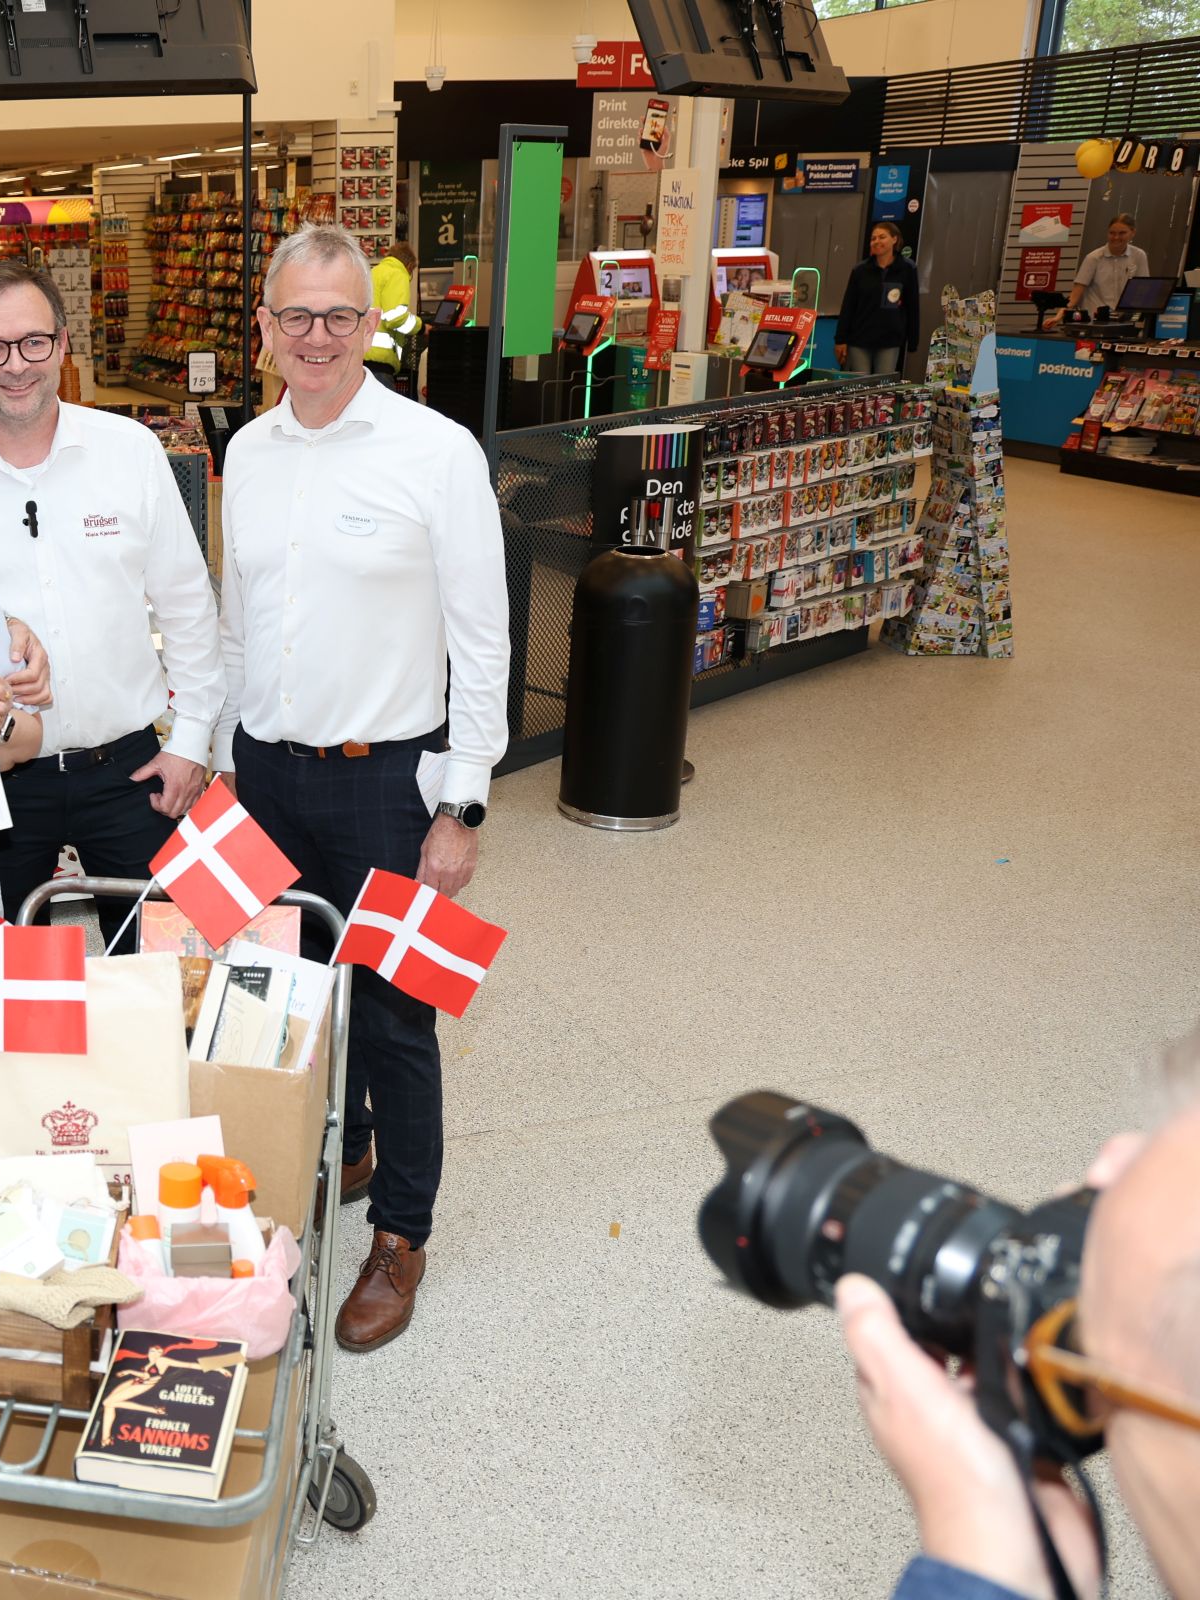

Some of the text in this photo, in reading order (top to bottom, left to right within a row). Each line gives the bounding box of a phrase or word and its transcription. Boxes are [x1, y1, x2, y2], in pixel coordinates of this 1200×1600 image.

[599, 99, 627, 111] Print
[597, 117, 640, 129] direkte
[596, 135, 635, 147] fra din
[595, 153, 633, 165] mobil!
[749, 157, 769, 169] Spil
[829, 163, 856, 171] Danmark
[604, 272, 612, 289] 2
[799, 283, 809, 302] 3
[1039, 363, 1094, 378] postnord
[646, 479, 683, 497] Den
[83, 516, 118, 528] Brugsen
[174, 1384, 204, 1396] LOTTE
[159, 1390, 215, 1406] GARBERS
[145, 1417, 190, 1432] FRØKEN
[117, 1423, 211, 1451] SANNOMS
[139, 1444, 182, 1458] VINGER
